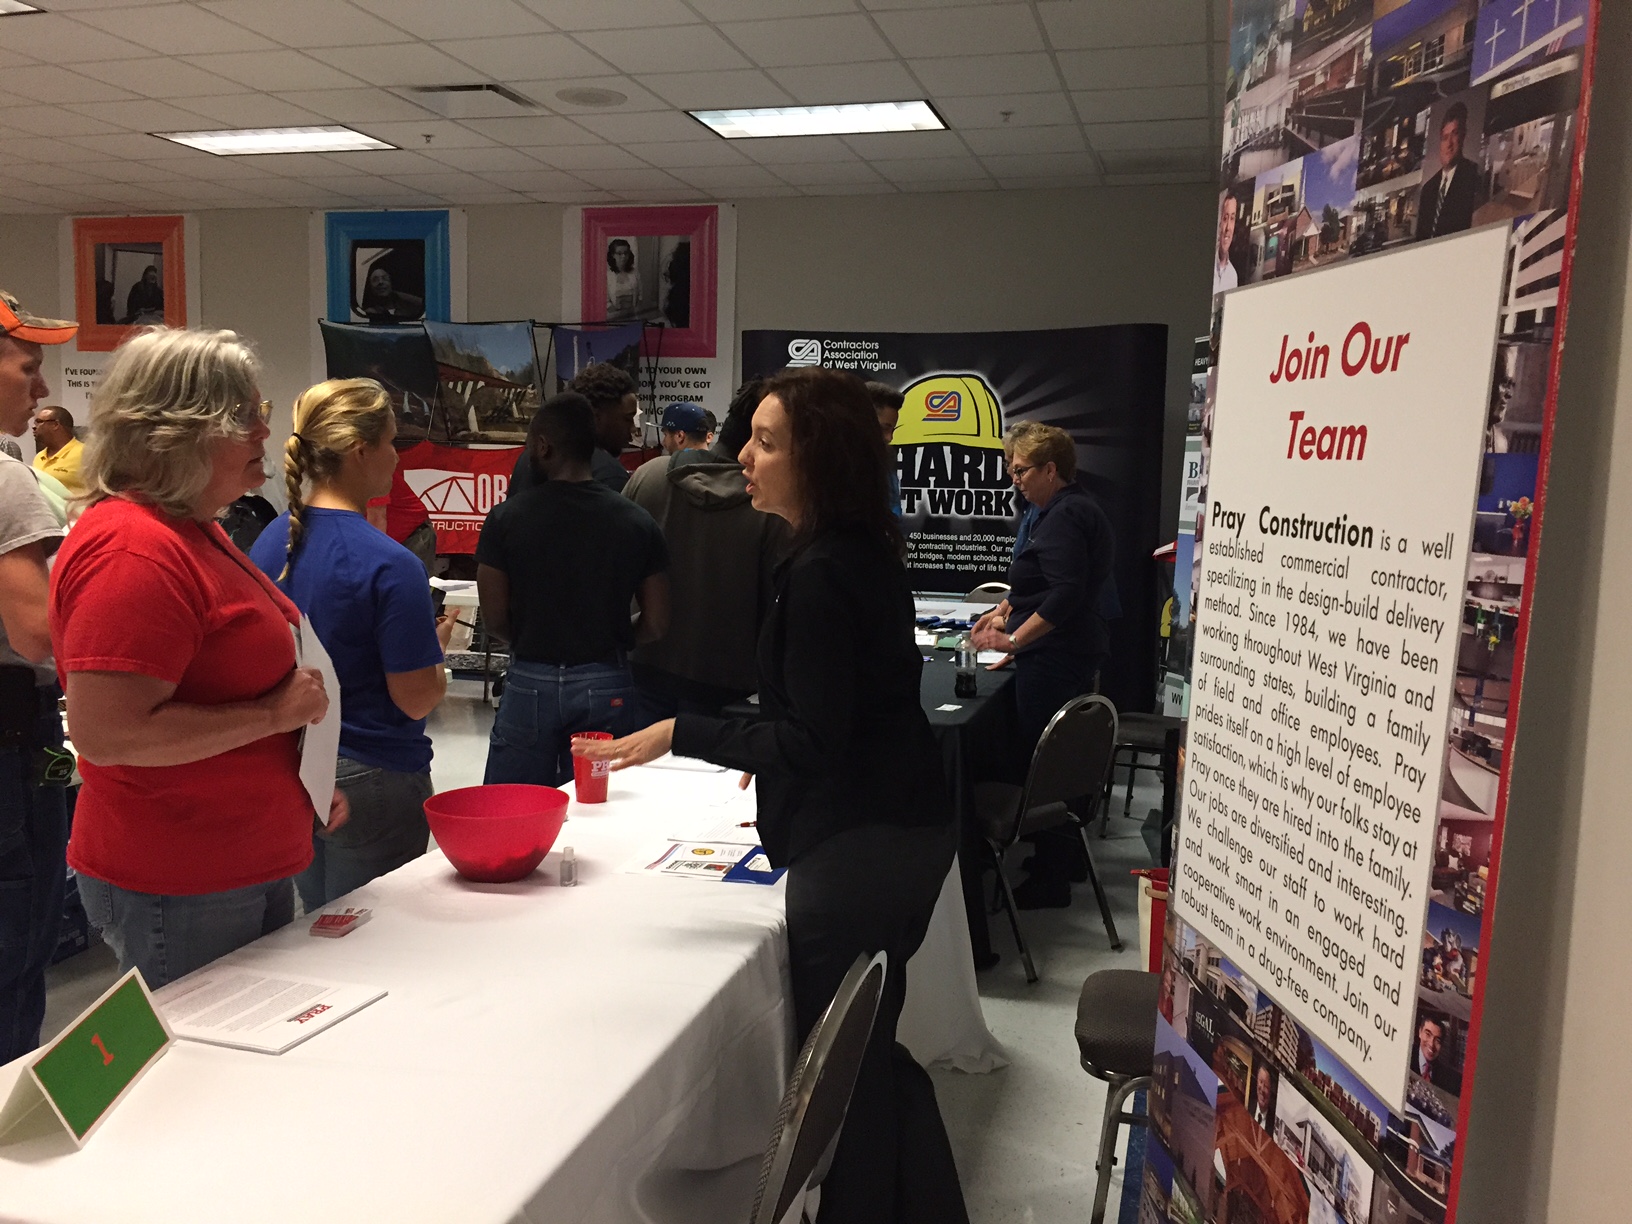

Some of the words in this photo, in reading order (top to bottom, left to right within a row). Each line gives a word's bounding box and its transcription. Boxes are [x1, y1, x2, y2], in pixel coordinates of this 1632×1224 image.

[684, 367, 706, 375] OWN
[823, 340, 879, 349] Contractors
[823, 350, 878, 359] Association
[823, 361, 833, 369] of
[834, 361, 858, 369] West
[860, 361, 897, 372] Virginia
[1269, 330, 1330, 384] Join
[1341, 321, 1410, 377] Our
[659, 380, 690, 388] YOU'VE
[1287, 411, 1368, 461] Team
[927, 489, 1014, 516] WORK
[1212, 501, 1246, 538] Pray
[1259, 505, 1373, 549] Construction
[1380, 529, 1391, 551] is
[1398, 538, 1408, 553] a
[1422, 532, 1454, 560] well
[909, 532, 921, 540] 450
[922, 533, 958, 541] businesses
[972, 534, 995, 543] 20,000
[913, 561, 944, 569] increases
[945, 562, 956, 570] the
[956, 563, 978, 572] quality
[987, 564, 997, 572] life
[998, 564, 1008, 572] for
[918, 543, 954, 552] contracting
[955, 543, 989, 552] industries.
[991, 544, 1004, 552] Our
[919, 552, 945, 561] bridges,
[972, 554, 998, 562] schools
[1209, 537, 1264, 563] established
[1281, 555, 1350, 579] commercial
[1371, 570, 1447, 601] contractor,
[1205, 593, 1242, 618] method.
[1248, 602, 1276, 628] Since
[1286, 611, 1319, 642] 1984,
[1328, 630, 1346, 647] we
[1356, 627, 1390, 660] have
[1401, 639, 1438, 674] been
[1207, 567, 1257, 598] specilizing
[1261, 576, 1271, 595] in
[1276, 577, 1293, 601] the
[1299, 581, 1380, 621] design-build
[1386, 599, 1445, 643] delivery
[1202, 621, 1239, 652] working
[1244, 629, 1302, 667] throughout
[1308, 650, 1338, 679] West
[1344, 661, 1396, 699] Virginia
[1404, 685, 1435, 712] and
[1198, 672, 1208, 691] of
[1214, 676, 1235, 703] field
[1242, 694, 1263, 715] and
[1271, 702, 1300, 731] office
[1310, 724, 1381, 768] employees.
[1394, 752, 1427, 793] Pray
[1200, 651, 1256, 688] surrounding
[1263, 671, 1296, 699] states,
[1305, 680, 1356, 727] building
[1367, 712, 1376, 728] a
[1387, 709, 1431, 756] family
[1193, 731, 1246, 770] satisfaction,
[1248, 755, 1278, 785] which
[1280, 770, 1288, 791] is
[1291, 776, 1315, 809] why
[1316, 795, 1338, 816] our
[1340, 797, 1369, 834] folks
[1372, 822, 1400, 856] stay
[1402, 841, 1418, 861] at
[1195, 704, 1223, 727] prides
[1226, 713, 1249, 738] itself
[1250, 730, 1263, 746] on
[1266, 737, 1273, 751] a
[1277, 733, 1301, 767] high
[1305, 746, 1334, 780] level
[1337, 764, 1351, 788] of
[1353, 778, 1421, 824] employee
[1190, 779, 1207, 803] Our
[1208, 791, 1228, 817] jobs
[1231, 809, 1247, 829] are
[1250, 814, 1305, 866] diversified
[1308, 857, 1333, 883] and
[1337, 869, 1408, 938] interesting.
[1191, 752, 1211, 782] Pray
[1213, 770, 1236, 792] once
[1239, 777, 1259, 810] they
[1262, 797, 1279, 817] are
[1283, 800, 1313, 837] hired
[1316, 822, 1339, 852] into
[1344, 836, 1364, 867] the
[1368, 848, 1412, 901] family.
[1188, 804, 1202, 829] We
[1207, 818, 1253, 864] challenge
[1259, 858, 1277, 879] our
[1283, 873, 1308, 900] staff
[1314, 890, 1325, 913] to
[1334, 907, 1364, 941] work
[1372, 925, 1405, 970] hard
[1183, 863, 1235, 911] cooperative
[1238, 904, 1262, 933] work
[1266, 926, 1338, 994] environment.
[1343, 981, 1369, 1019] Join
[1374, 1013, 1397, 1041] our
[1185, 837, 1203, 858] and
[1208, 852, 1230, 878] work
[1235, 872, 1262, 901] smart
[1268, 891, 1278, 913] in
[1285, 909, 1300, 929] an
[1307, 925, 1366, 978] engaged
[1373, 974, 1401, 1007] and
[1181, 887, 1208, 918] robust
[1211, 908, 1233, 940] team
[1236, 928, 1245, 950] in
[1248, 944, 1255, 959] a
[1259, 946, 1309, 1004] drug-free
[1313, 998, 1372, 1062] company.
